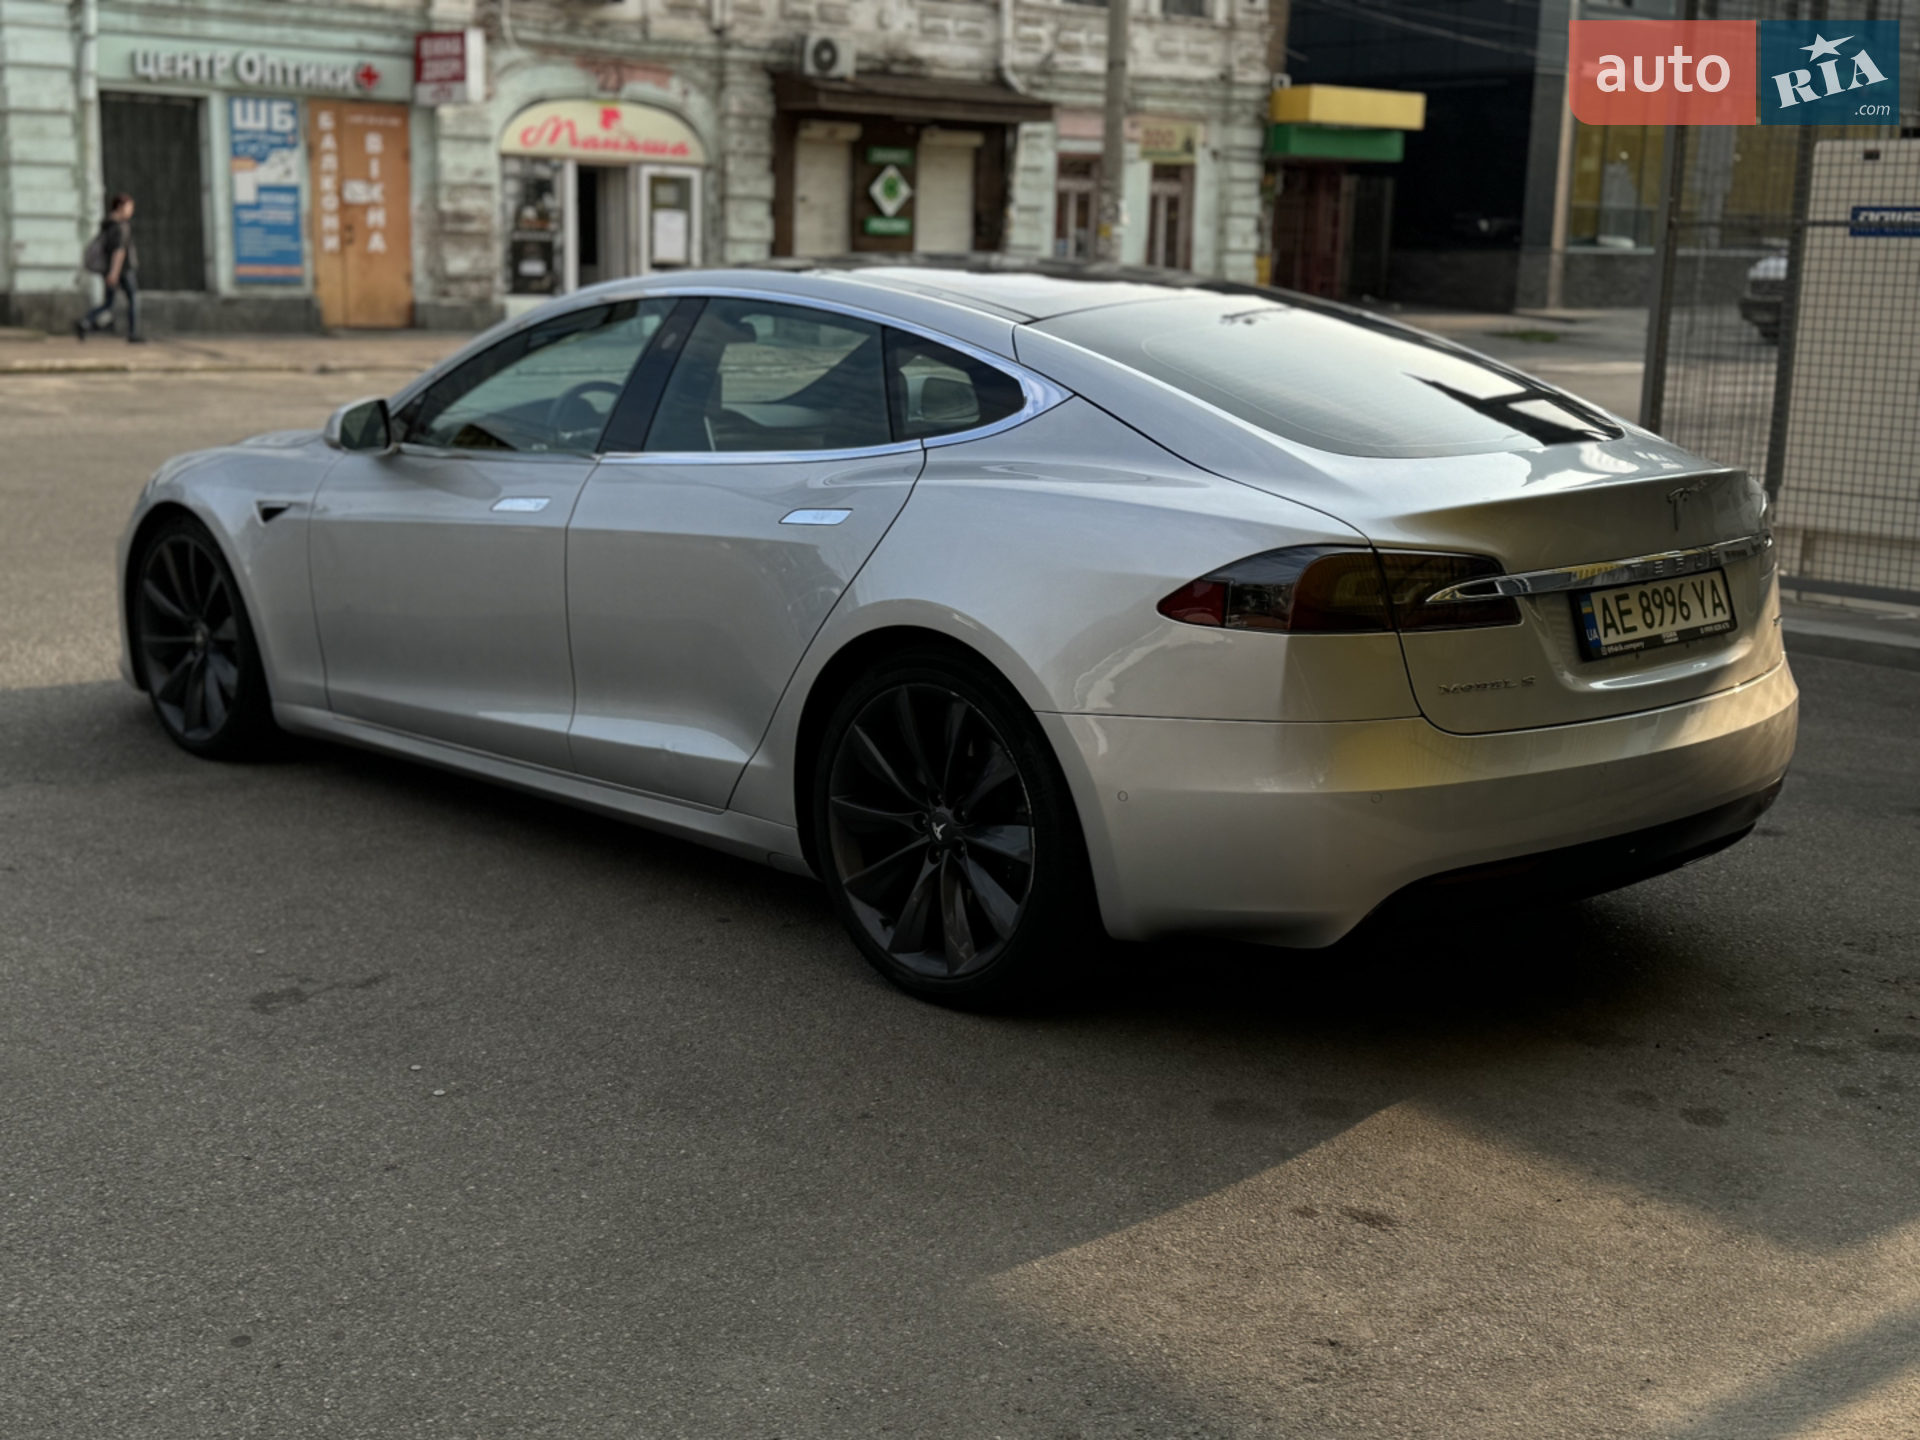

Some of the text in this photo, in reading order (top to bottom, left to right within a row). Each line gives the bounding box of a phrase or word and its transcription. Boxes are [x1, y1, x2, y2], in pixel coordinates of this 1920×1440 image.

[1601, 578, 1727, 638] AE 8996 YA
[1586, 627, 1600, 642] UA
[1437, 675, 1538, 696] MODEL S
